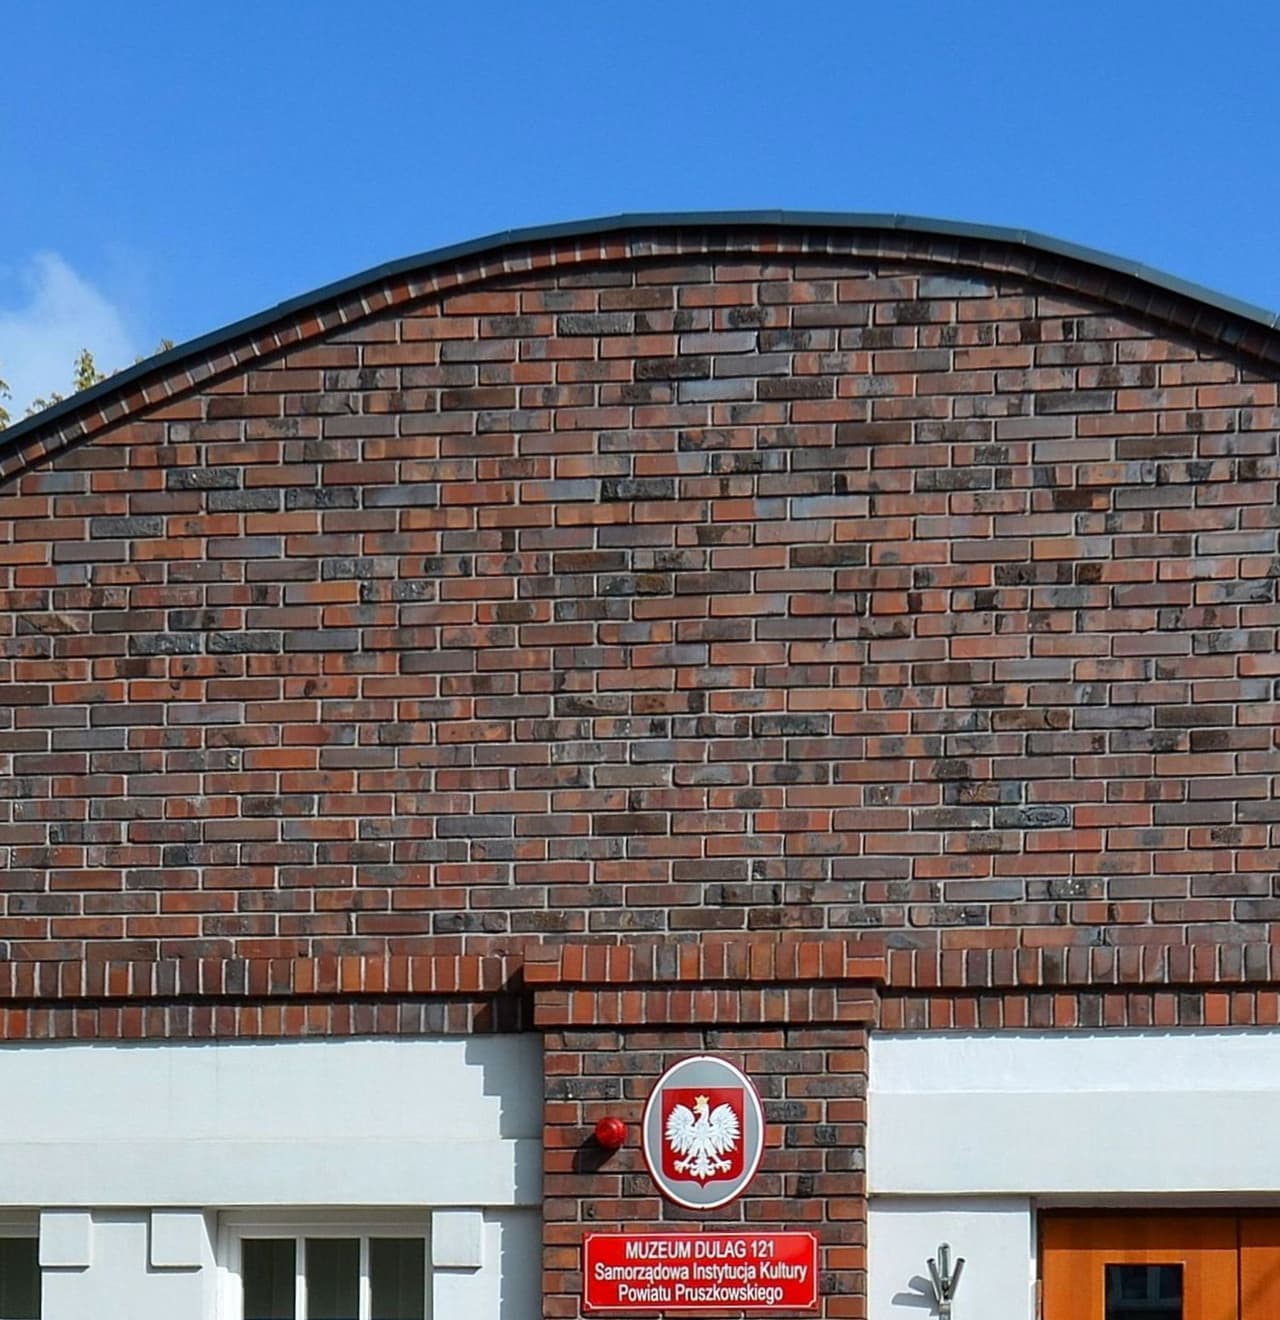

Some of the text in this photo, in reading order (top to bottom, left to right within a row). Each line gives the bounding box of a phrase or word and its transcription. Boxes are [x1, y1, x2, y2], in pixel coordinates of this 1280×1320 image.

[626, 1240, 774, 1259] MUZEUM DULAG 121
[595, 1261, 808, 1283] Samorządowa Instytucja Kultury
[618, 1283, 784, 1304] Powiatu Pruszkowskiego
